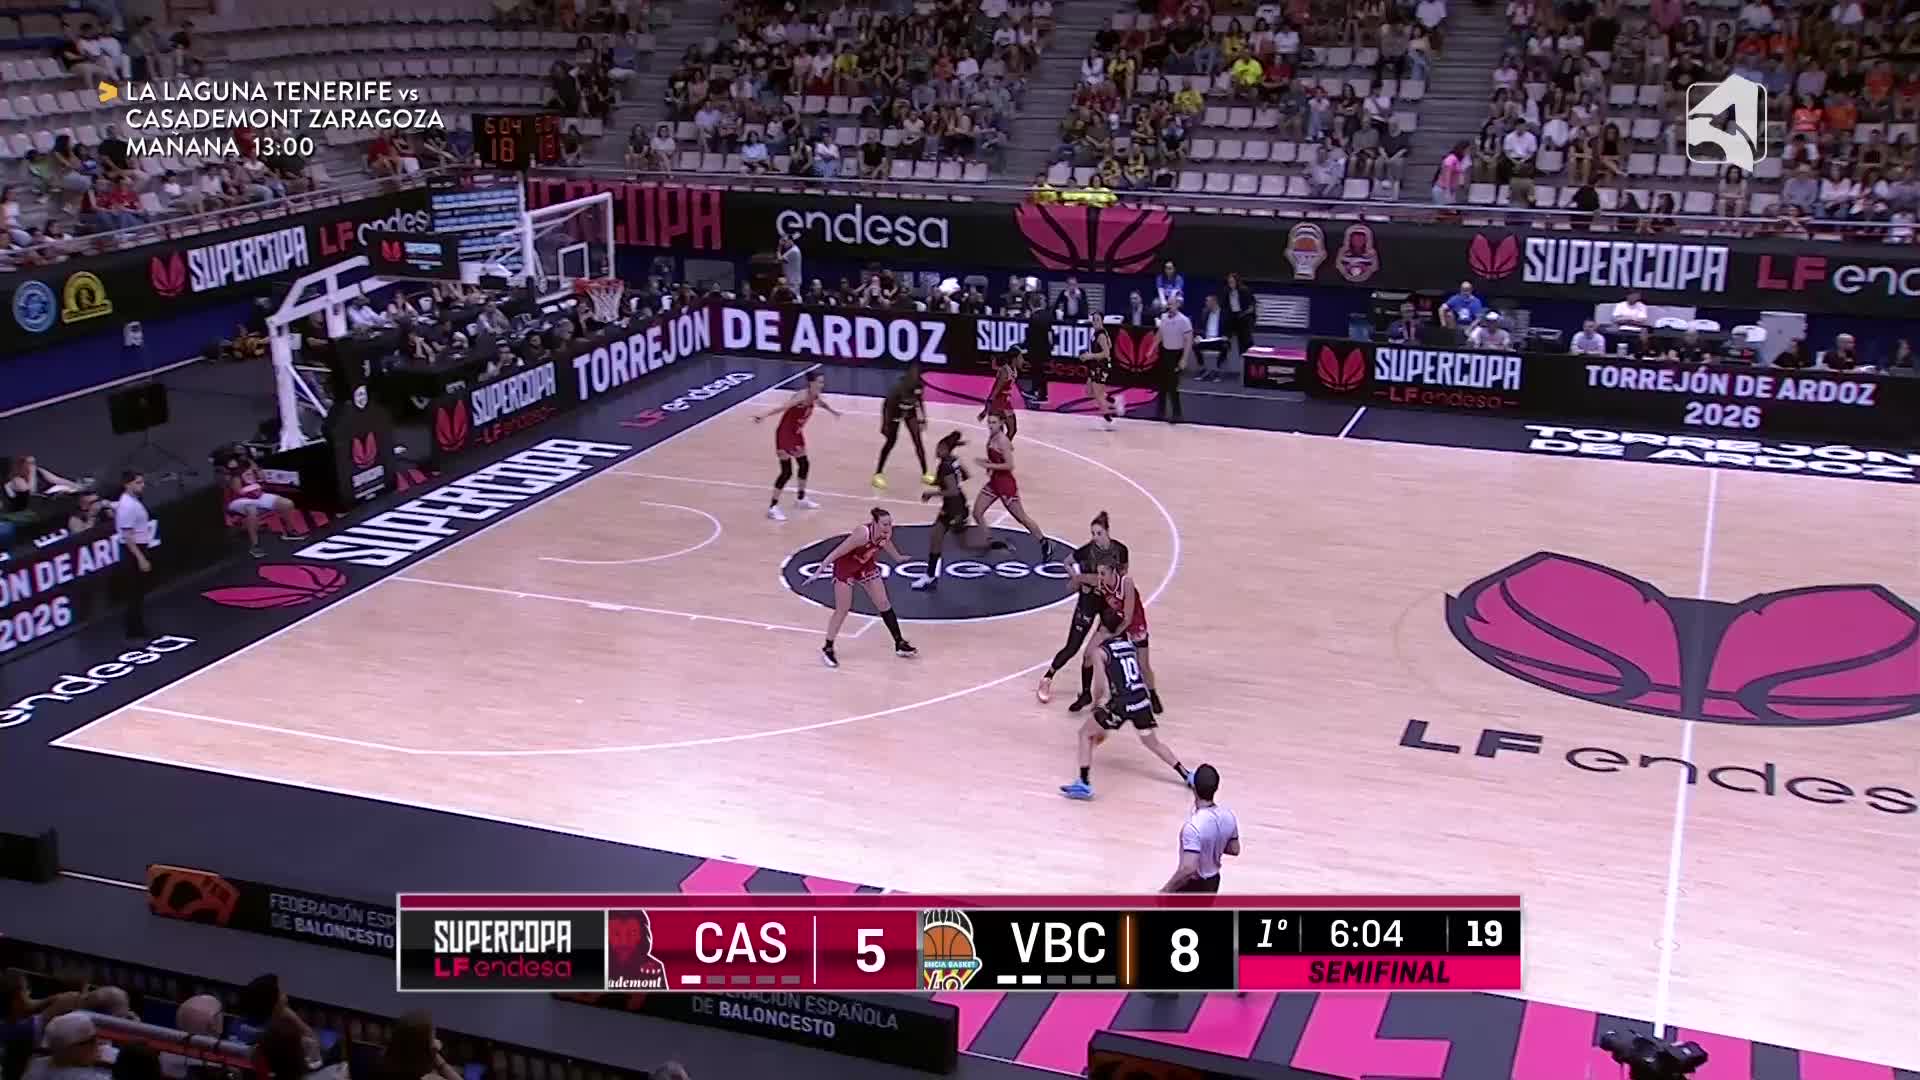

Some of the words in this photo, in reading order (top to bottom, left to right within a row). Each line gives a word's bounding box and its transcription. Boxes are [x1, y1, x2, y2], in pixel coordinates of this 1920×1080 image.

[775, 203, 949, 249] endesa
[188, 225, 310, 292] SUPERCOPA
[320, 221, 354, 256] LF
[1523, 237, 1730, 293] SUPERCOPA
[1757, 255, 1827, 291] LF
[573, 304, 711, 400] TORREJÓN
[722, 306, 781, 353] DE
[791, 313, 948, 365] ARDOZ
[1375, 347, 1522, 391] SUPERCOPA
[471, 361, 557, 427] SUPERCOPA
[1388, 386, 1417, 403] LF
[1586, 364, 1731, 397] TORREJÓN
[1735, 374, 1773, 399] DE
[1776, 378, 1877, 406] ARDOZ
[1684, 402, 1761, 429] 2026
[1529, 438, 1625, 457] DE
[1648, 448, 1915, 480] ARDOZ
[293, 439, 633, 568] SUPERCOPA
[33, 552, 75, 592] DE
[0, 595, 72, 653] 2026
[1120, 657, 1140, 683] 10
[1399, 718, 1545, 759] LF
[294, 917, 395, 949] BALONCESTO
[691, 996, 714, 1015] DE
[719, 1001, 836, 1038] BALONCESTO
[804, 995, 899, 1030] ESPAÑOLA
